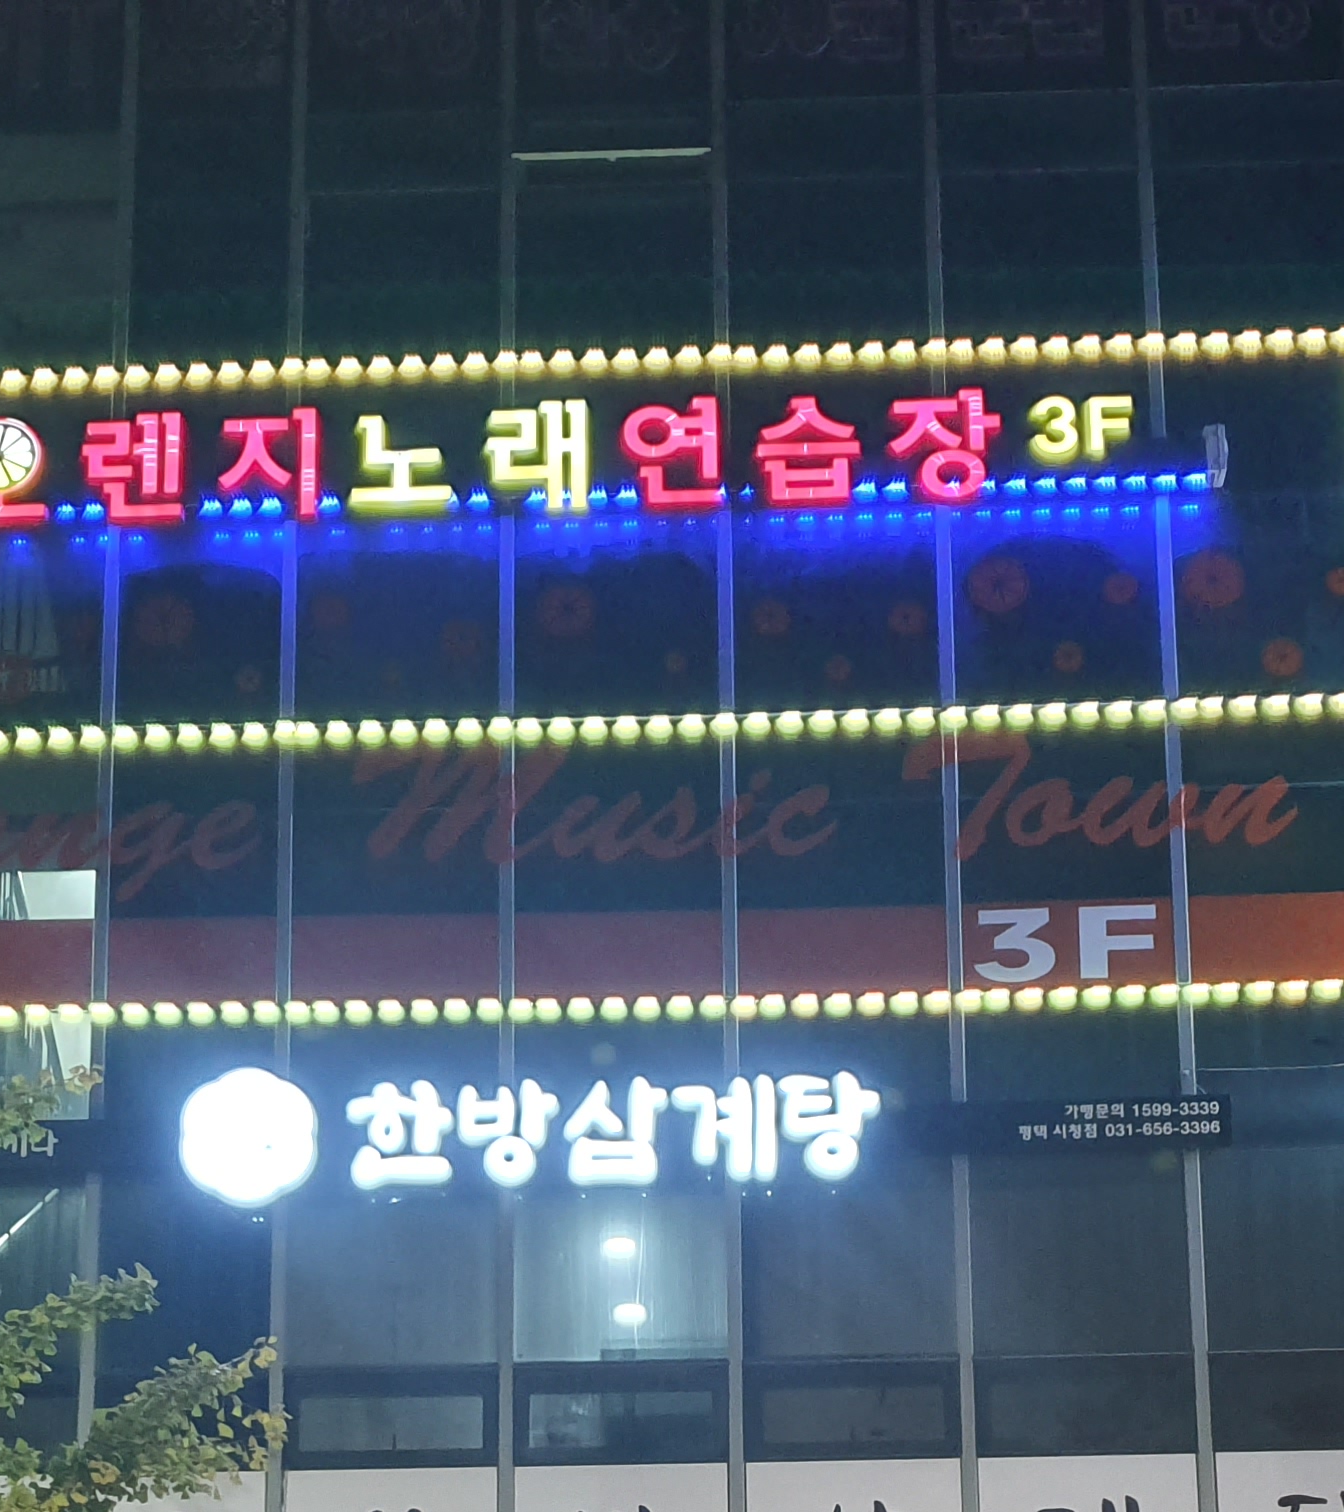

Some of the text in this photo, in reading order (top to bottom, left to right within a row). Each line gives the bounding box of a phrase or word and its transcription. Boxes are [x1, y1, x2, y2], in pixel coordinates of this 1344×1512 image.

[1031, 395, 1132, 463] 3F
[353, 745, 838, 864] Music
[901, 732, 1299, 858] Town
[972, 901, 1157, 984] 3F
[346, 1068, 882, 1190] 한방삼계탕
[1104, 1119, 1222, 1138] 031-656-3396
[1131, 1100, 1221, 1117] 1599-3339
